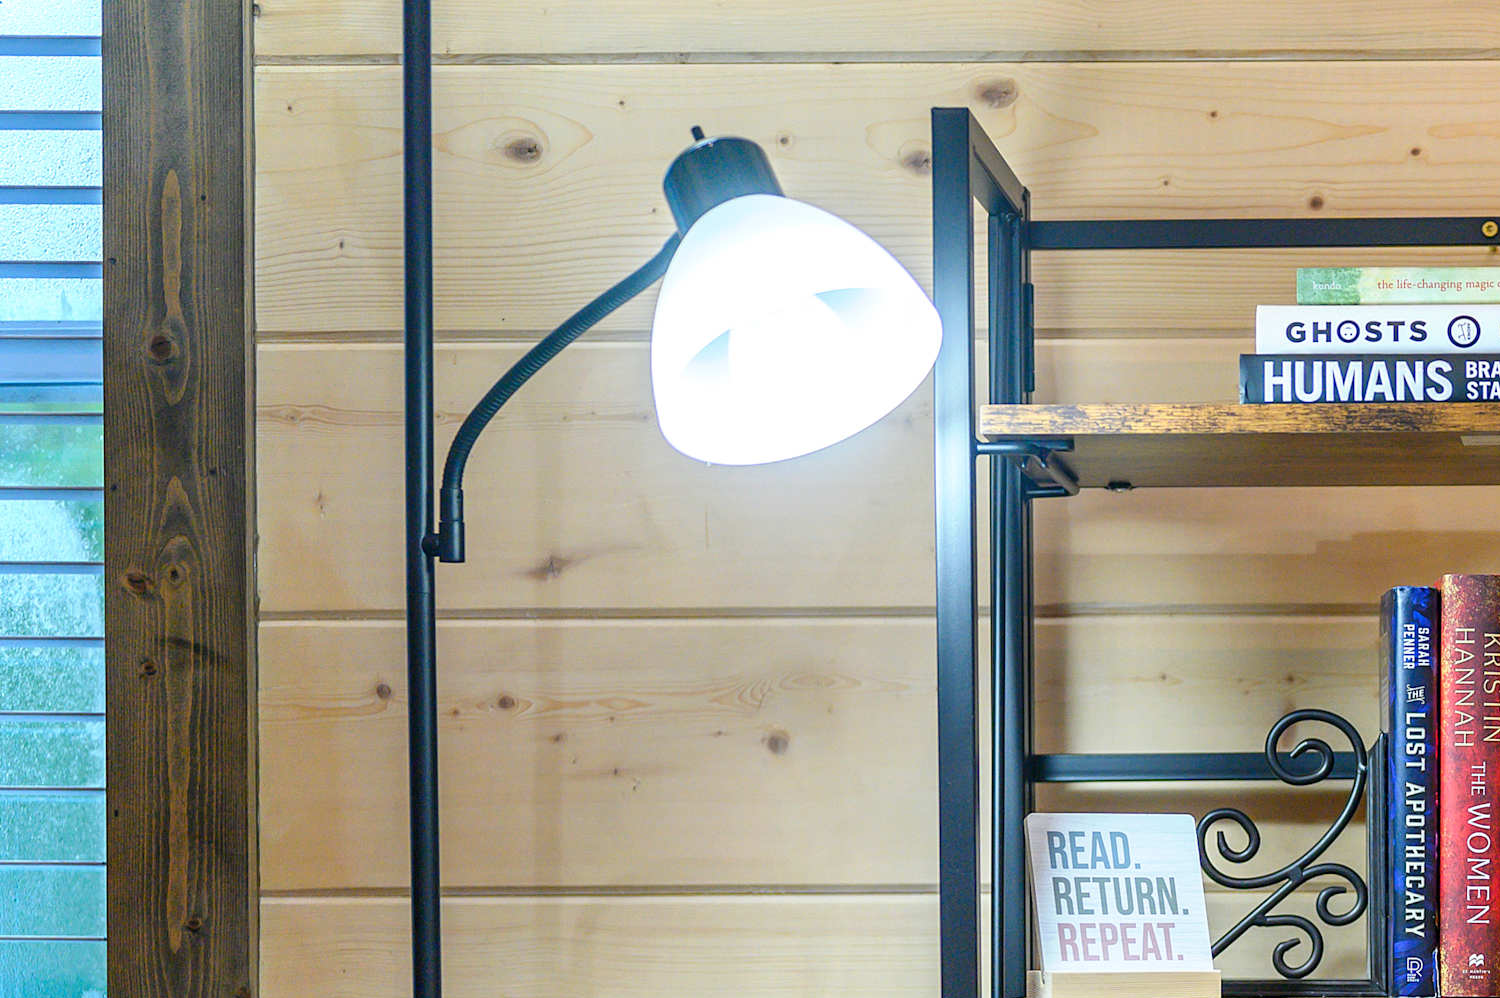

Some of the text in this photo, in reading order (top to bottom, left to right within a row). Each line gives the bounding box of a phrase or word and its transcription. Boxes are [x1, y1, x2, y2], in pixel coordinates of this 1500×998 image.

[1377, 278, 1393, 289] the
[1396, 278, 1462, 292] life-changing
[1466, 279, 1494, 291] magic
[1286, 320, 1428, 343] GHOSTS
[1264, 360, 1453, 402] HUMANS
[1403, 624, 1415, 669] PENNER
[1418, 627, 1430, 667] SARAH
[1454, 627, 1475, 747] HANNAH
[1405, 712, 1426, 937] LOST APOTHECARY
[1466, 762, 1491, 924] THE WOMEN
[1047, 831, 1141, 869] READ.
[1052, 877, 1189, 915] RETURN.
[1057, 923, 1184, 961] REPEAT.
